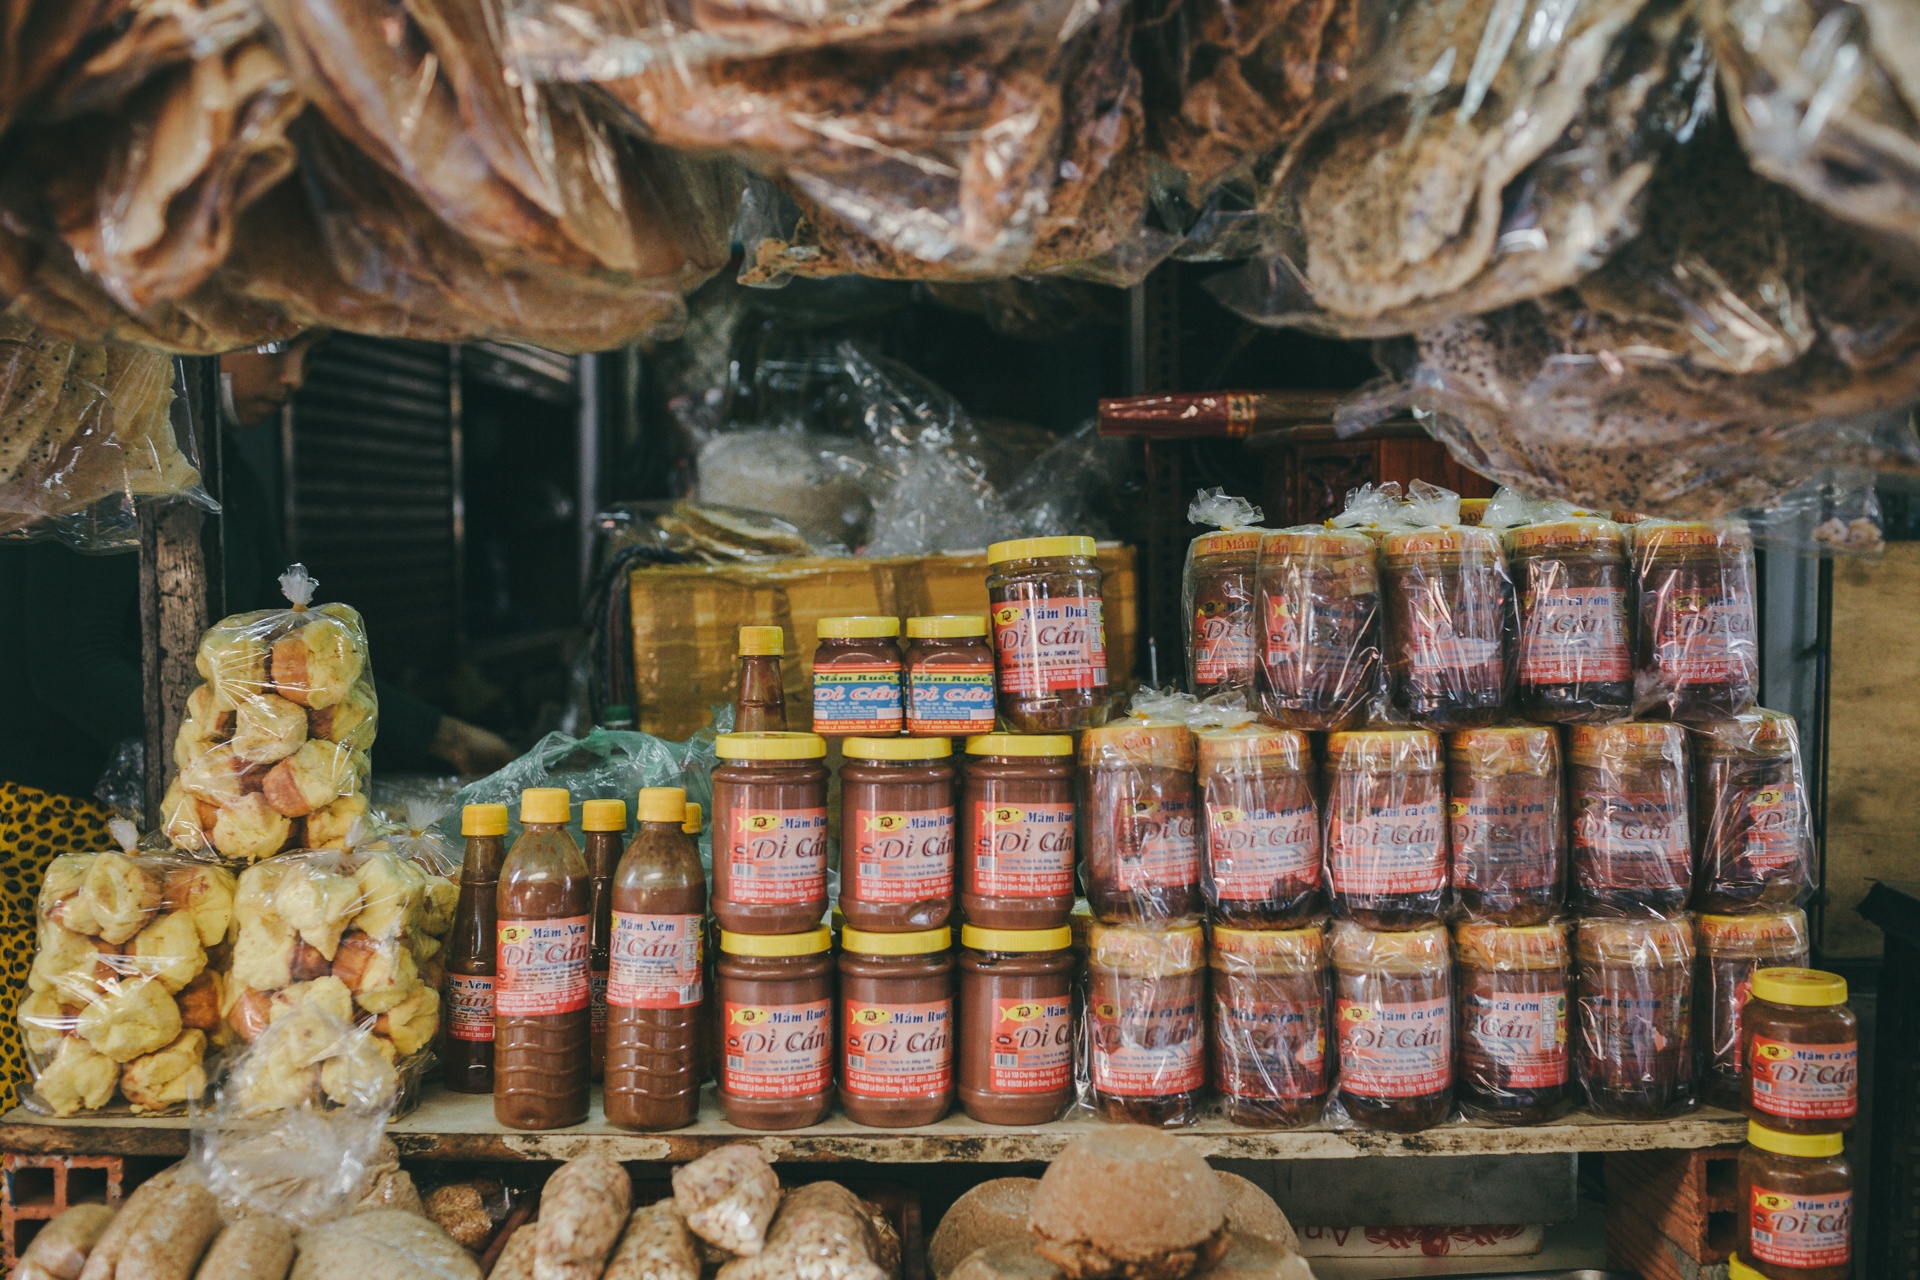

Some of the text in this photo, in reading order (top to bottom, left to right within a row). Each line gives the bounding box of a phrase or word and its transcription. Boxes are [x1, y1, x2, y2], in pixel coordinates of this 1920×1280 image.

[1000, 622, 1085, 649] Dì Cẩn
[820, 672, 894, 681] Mắm Ruốc
[914, 673, 987, 682] Mắm Ruốc
[814, 685, 900, 701] Dì Cẩn
[944, 687, 993, 701] Cẩn
[780, 815, 810, 829] Mắm
[906, 815, 937, 829] Mắm
[1023, 810, 1054, 823] Mắm
[1268, 818, 1312, 845] Cẩn
[1390, 819, 1436, 846] Cẩn
[752, 832, 791, 859] Dì
[879, 834, 917, 858] Dì
[996, 828, 1034, 852] Dì
[529, 924, 586, 938] Mắm Nêm
[618, 917, 674, 931] Mắm Nêm
[504, 937, 587, 965] Dì Cẩn
[627, 935, 680, 957] Cẩn
[465, 980, 492, 989] Nêm
[1043, 1003, 1066, 1018] Mắm
[1514, 1001, 1539, 1011] cơm
[768, 1010, 801, 1024] Mắm
[889, 1010, 923, 1024] Mắm
[1015, 1022, 1053, 1048] Dì
[1479, 1015, 1537, 1039] Cẩn
[742, 1025, 825, 1053] Dì Cẩn
[863, 1027, 946, 1054] Dì Cẩn
[1397, 1022, 1441, 1049] Cẩn
[1792, 1049, 1825, 1061] Mắm
[1771, 1061, 1855, 1085] Dì Cẩn
[1793, 1201, 1825, 1211] Mắm
[1771, 1212, 1807, 1234] Dì
